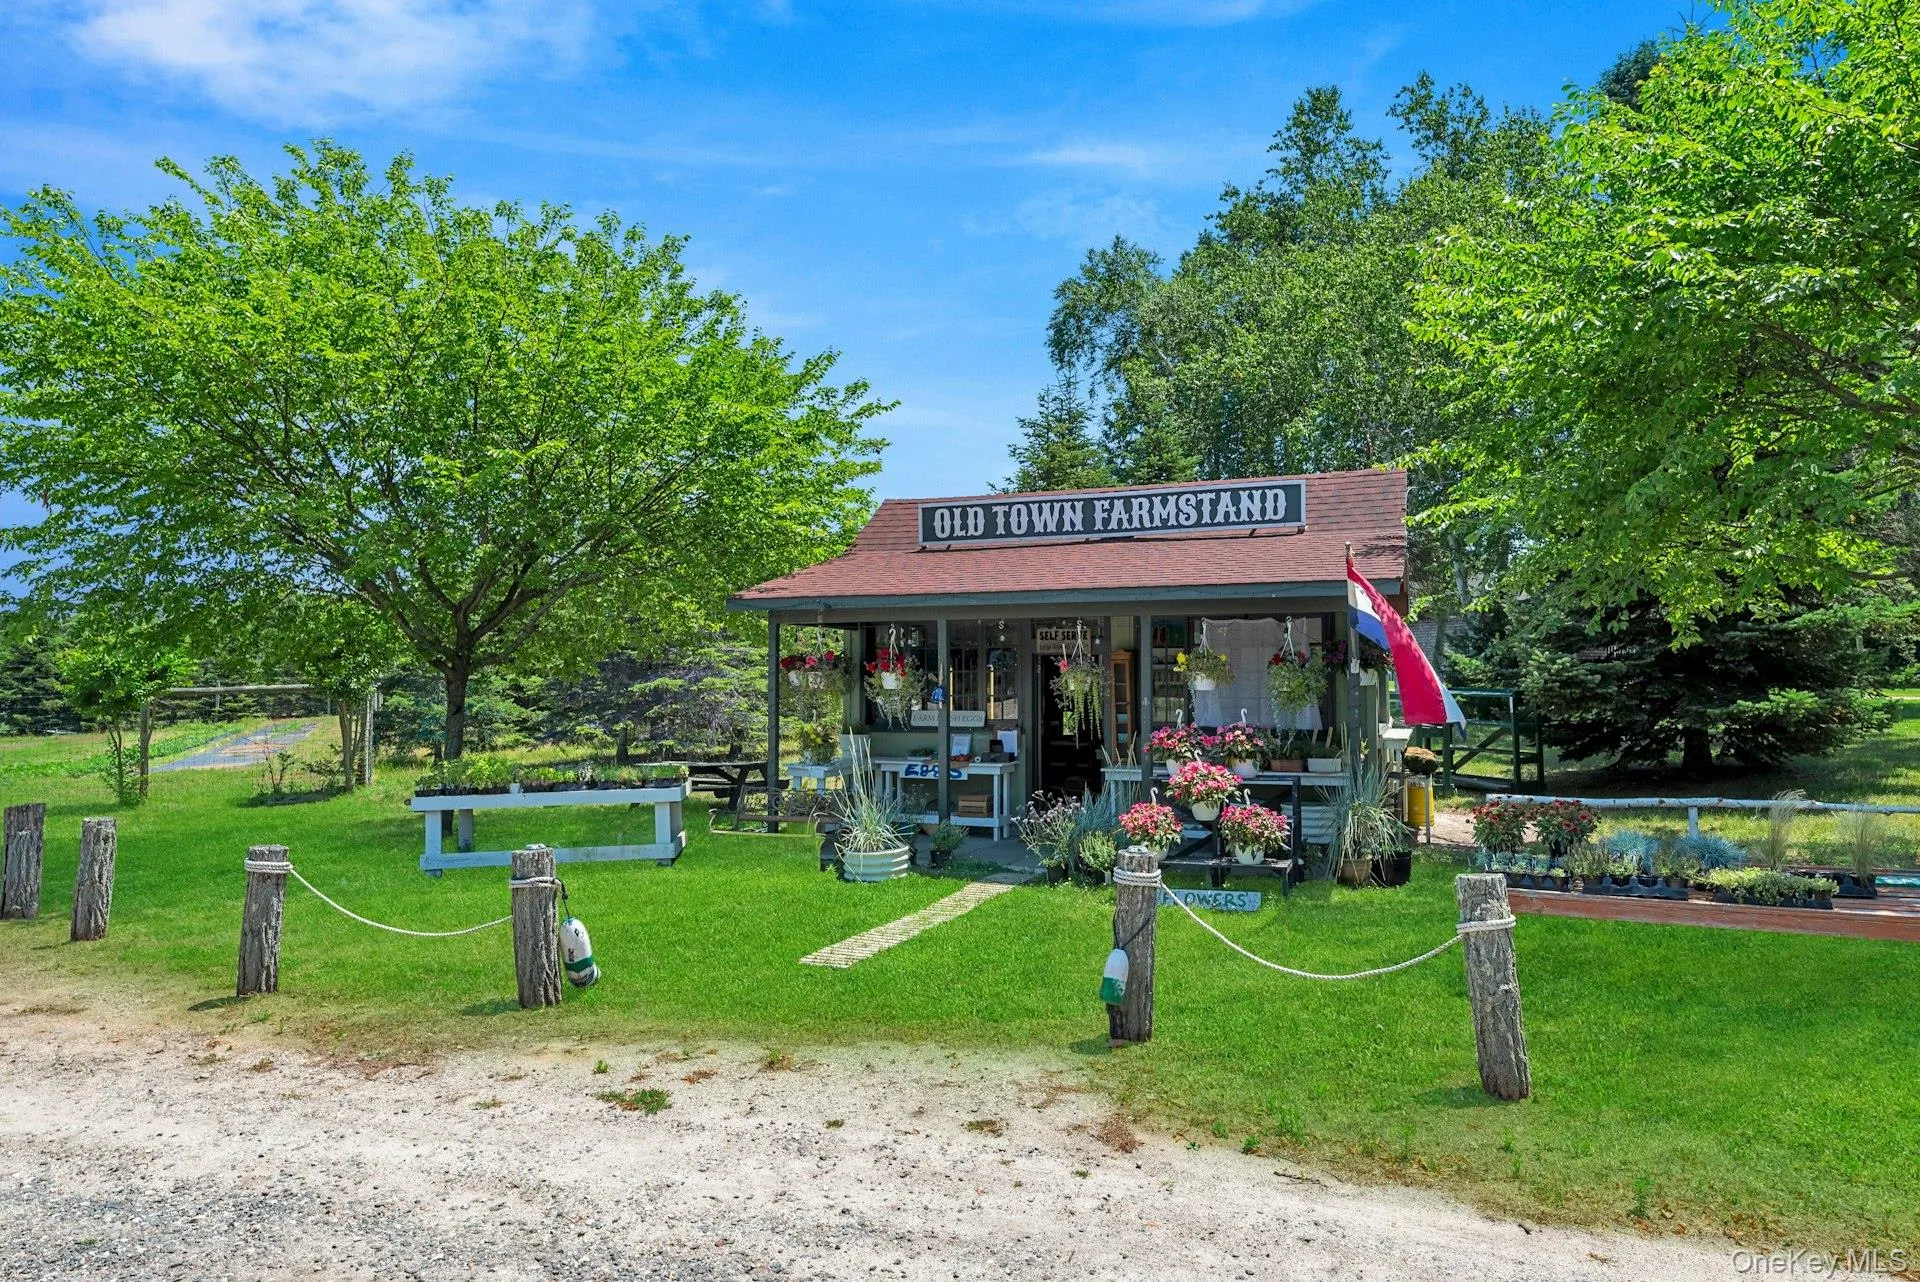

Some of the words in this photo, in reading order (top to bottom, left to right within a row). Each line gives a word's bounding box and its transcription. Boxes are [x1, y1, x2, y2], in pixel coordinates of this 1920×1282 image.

[933, 506, 986, 538] OLD
[992, 500, 1084, 535] TOWN
[1092, 488, 1287, 532] FARMSTAND
[1039, 630, 1059, 641] SELF
[913, 714, 935, 722] FARM
[962, 714, 983, 722] EGGS
